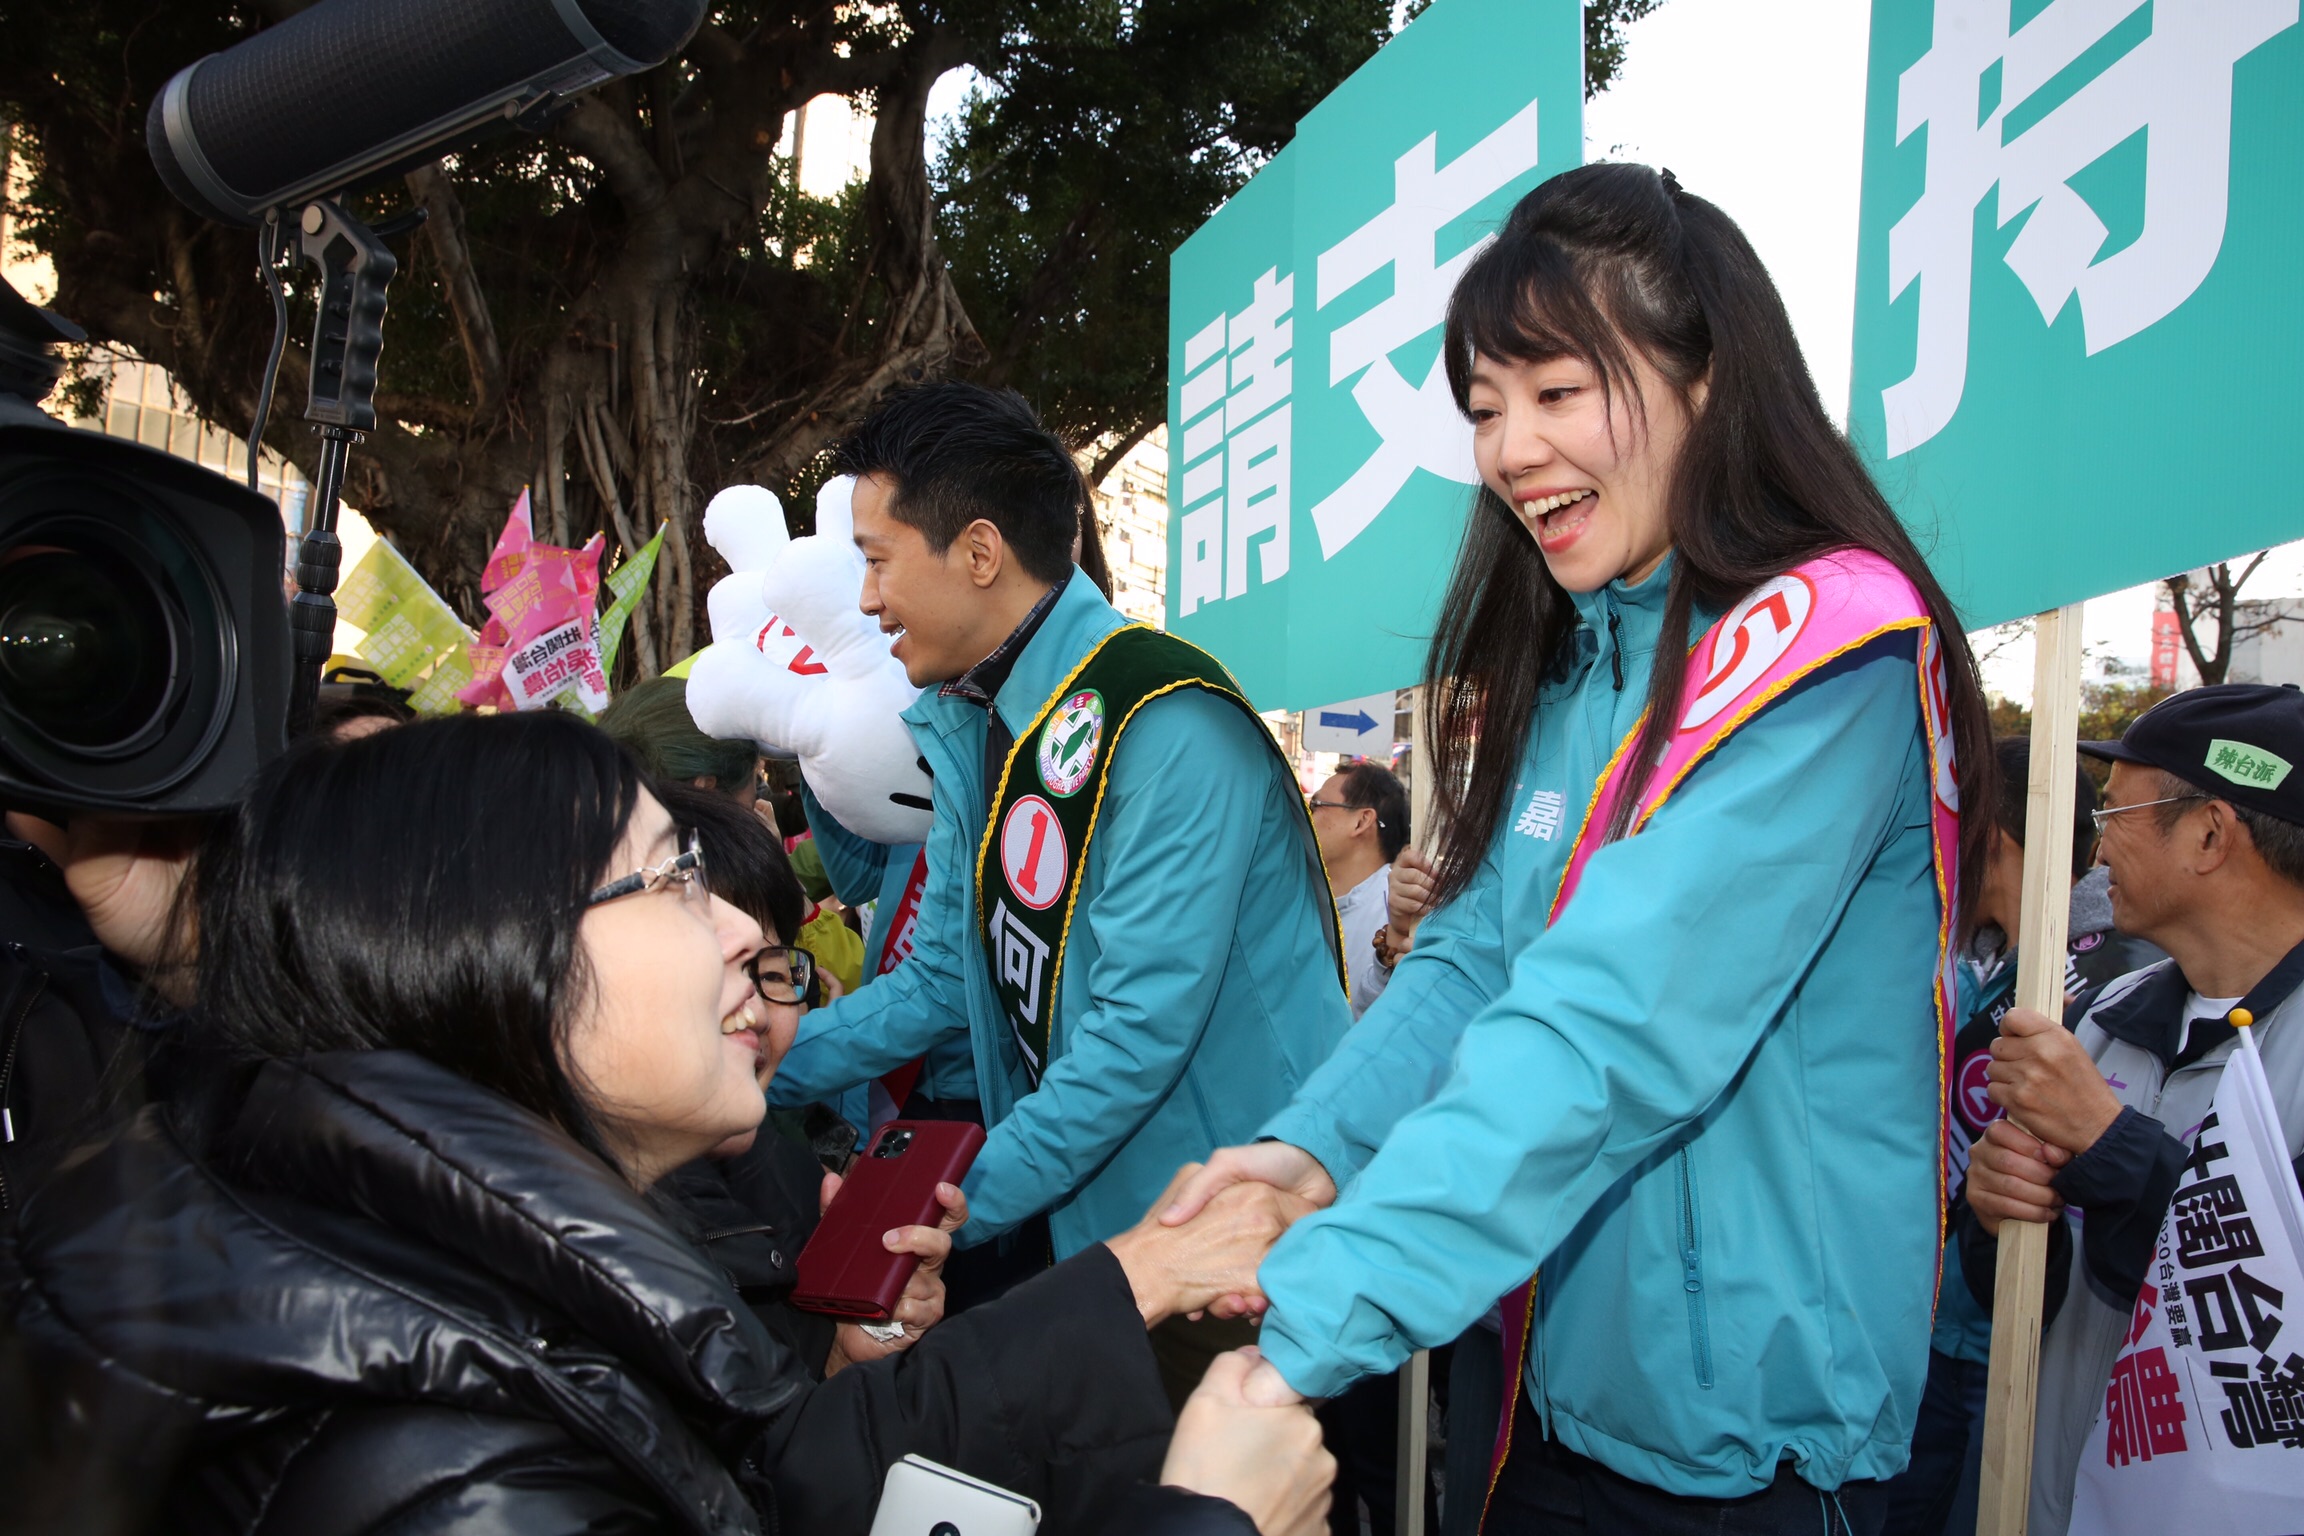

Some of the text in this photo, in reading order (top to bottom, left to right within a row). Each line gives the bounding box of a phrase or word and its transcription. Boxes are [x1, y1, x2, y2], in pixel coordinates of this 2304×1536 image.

[1311, 98, 1537, 561] 支
[1881, 0, 2299, 459] 持
[1179, 264, 1293, 617] 請
[1016, 809, 1048, 897] 1
[2213, 746, 2277, 783] 辣台派
[989, 897, 1050, 1087] 何
